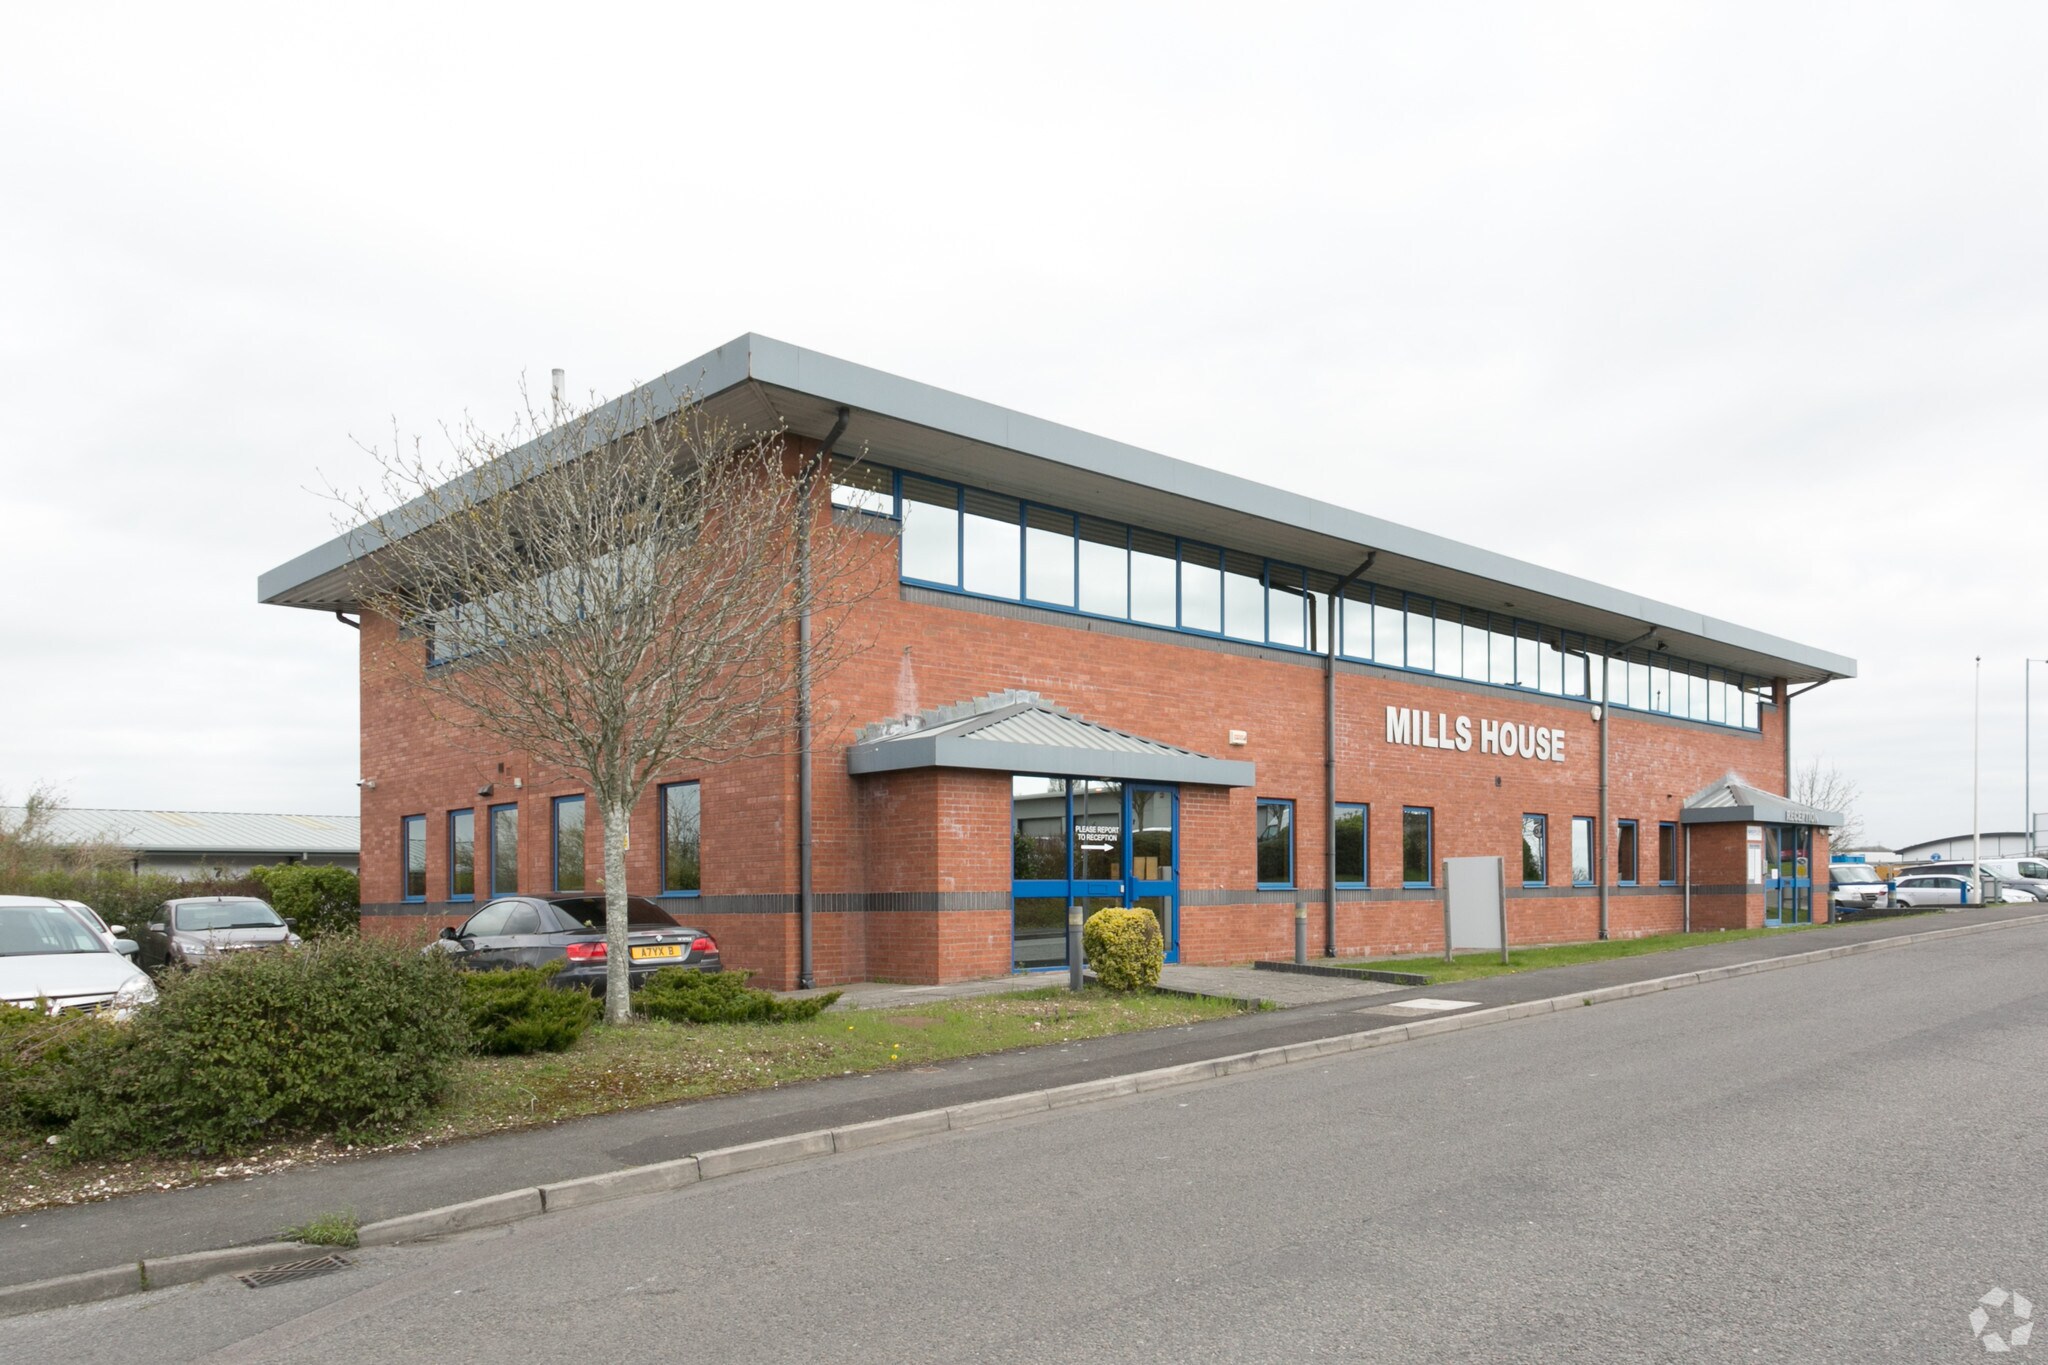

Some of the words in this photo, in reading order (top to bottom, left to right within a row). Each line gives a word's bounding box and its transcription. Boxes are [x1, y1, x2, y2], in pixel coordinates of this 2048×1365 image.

[1386, 706, 1472, 752] MILLS
[1480, 719, 1565, 762] HOUSE
[1075, 825, 1097, 833] PLEASE
[1097, 826, 1119, 834] REPORT
[1077, 833, 1086, 841] TO
[1086, 834, 1118, 842] RECEPTION
